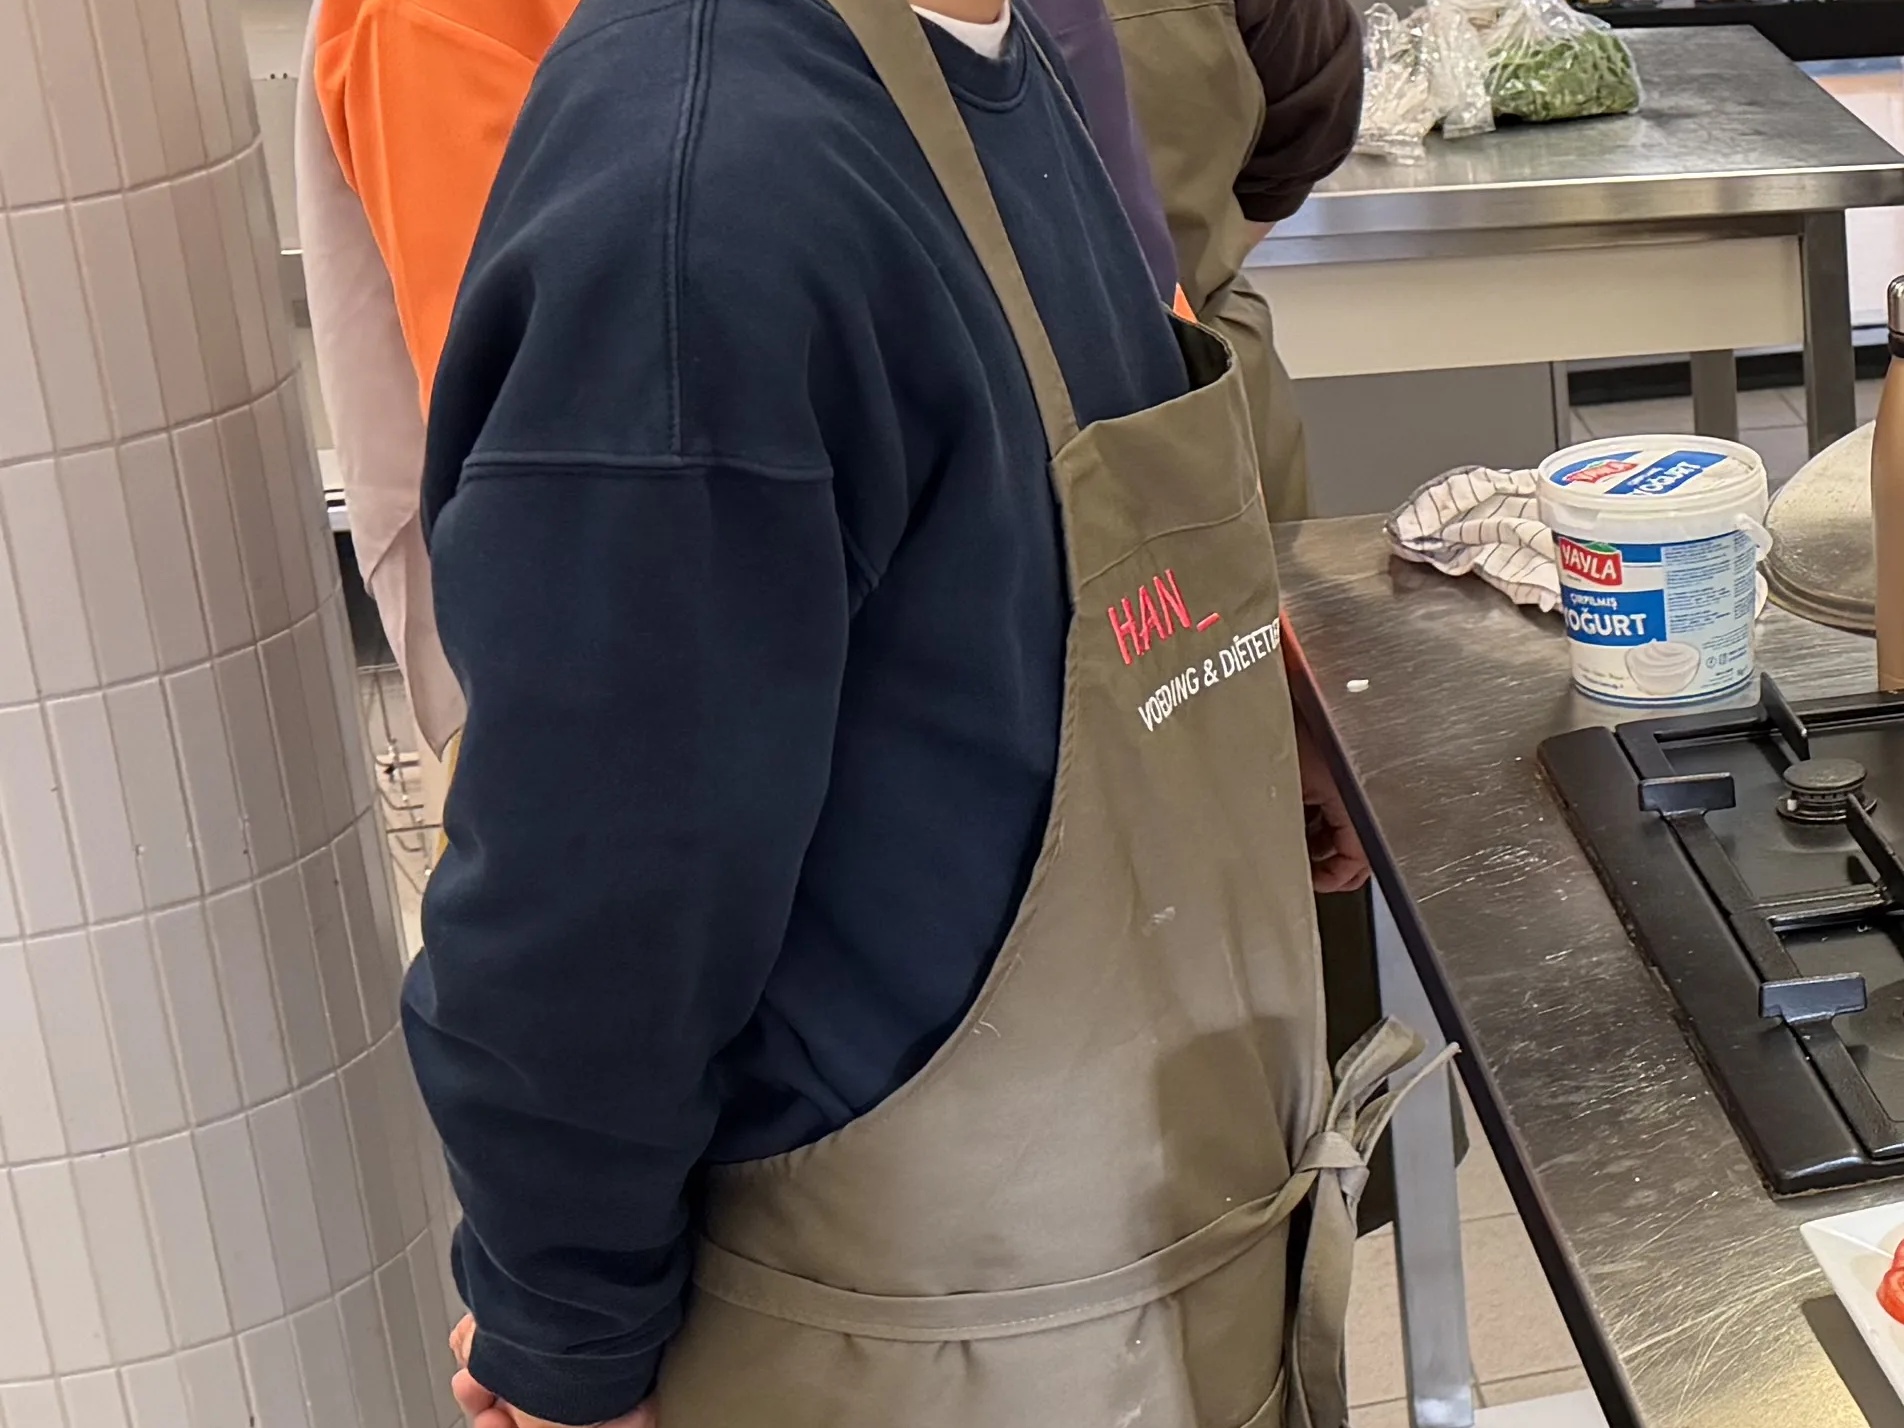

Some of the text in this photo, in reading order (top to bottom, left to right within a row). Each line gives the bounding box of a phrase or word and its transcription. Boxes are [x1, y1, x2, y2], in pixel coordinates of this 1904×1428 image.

[1561, 543, 1617, 581] YAYLA
[1138, 666, 1200, 732] VOEDING
[1203, 659, 1219, 686] &
